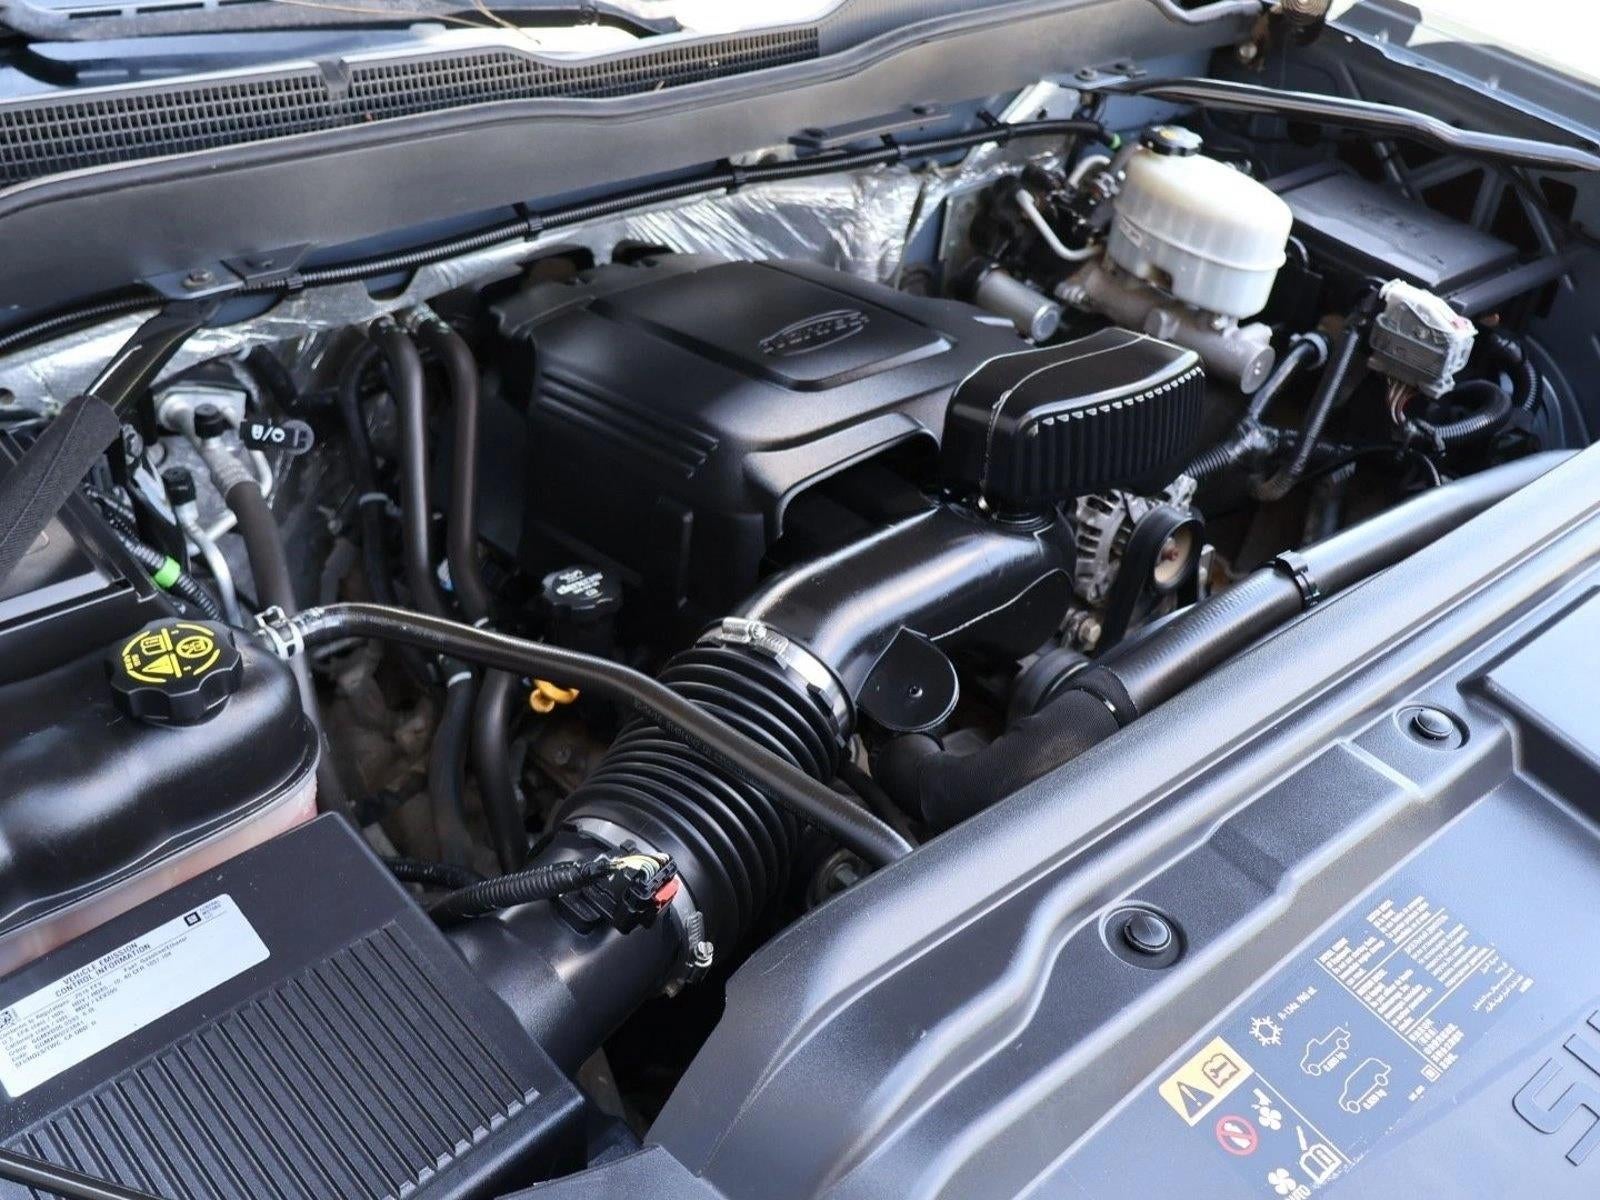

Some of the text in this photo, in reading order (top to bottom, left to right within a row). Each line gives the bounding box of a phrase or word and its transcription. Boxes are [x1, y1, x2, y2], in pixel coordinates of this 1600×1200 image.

[55, 974, 93, 997] CONTROL
[96, 943, 151, 976] INFORMATION
[63, 942, 138, 984] VEHICLE EMISSION
